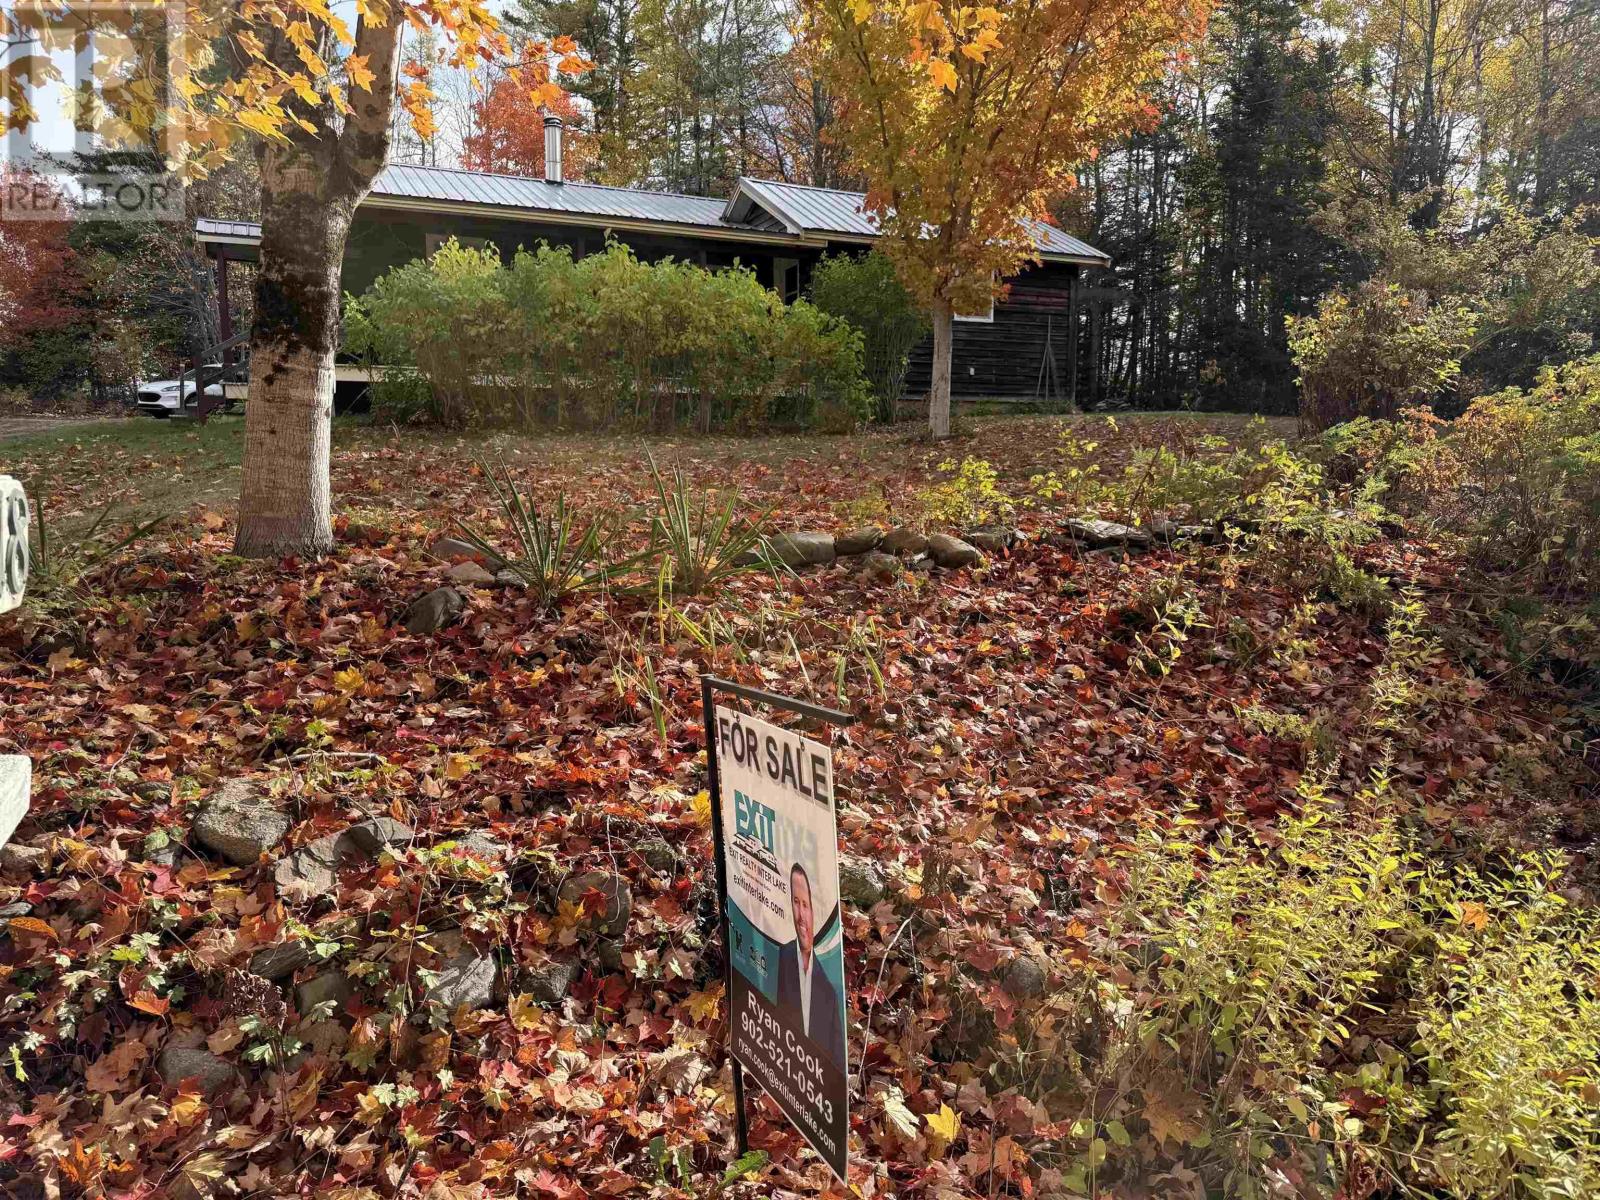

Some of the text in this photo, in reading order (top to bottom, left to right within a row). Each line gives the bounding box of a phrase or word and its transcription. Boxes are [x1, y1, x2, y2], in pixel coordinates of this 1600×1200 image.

[719, 716, 830, 806] FOR SALE
[734, 789, 776, 855] EXIT
[729, 847, 739, 861] EXIT
[772, 877, 787, 894] LAKE
[733, 875, 785, 919] exitinterlake.com
[741, 1011, 833, 1124] 902-521-0543
[748, 990, 781, 1039] Ryan
[785, 1029, 825, 1086] Cook
[738, 1038, 836, 1156] ryan.cook@exitinterlake.com
